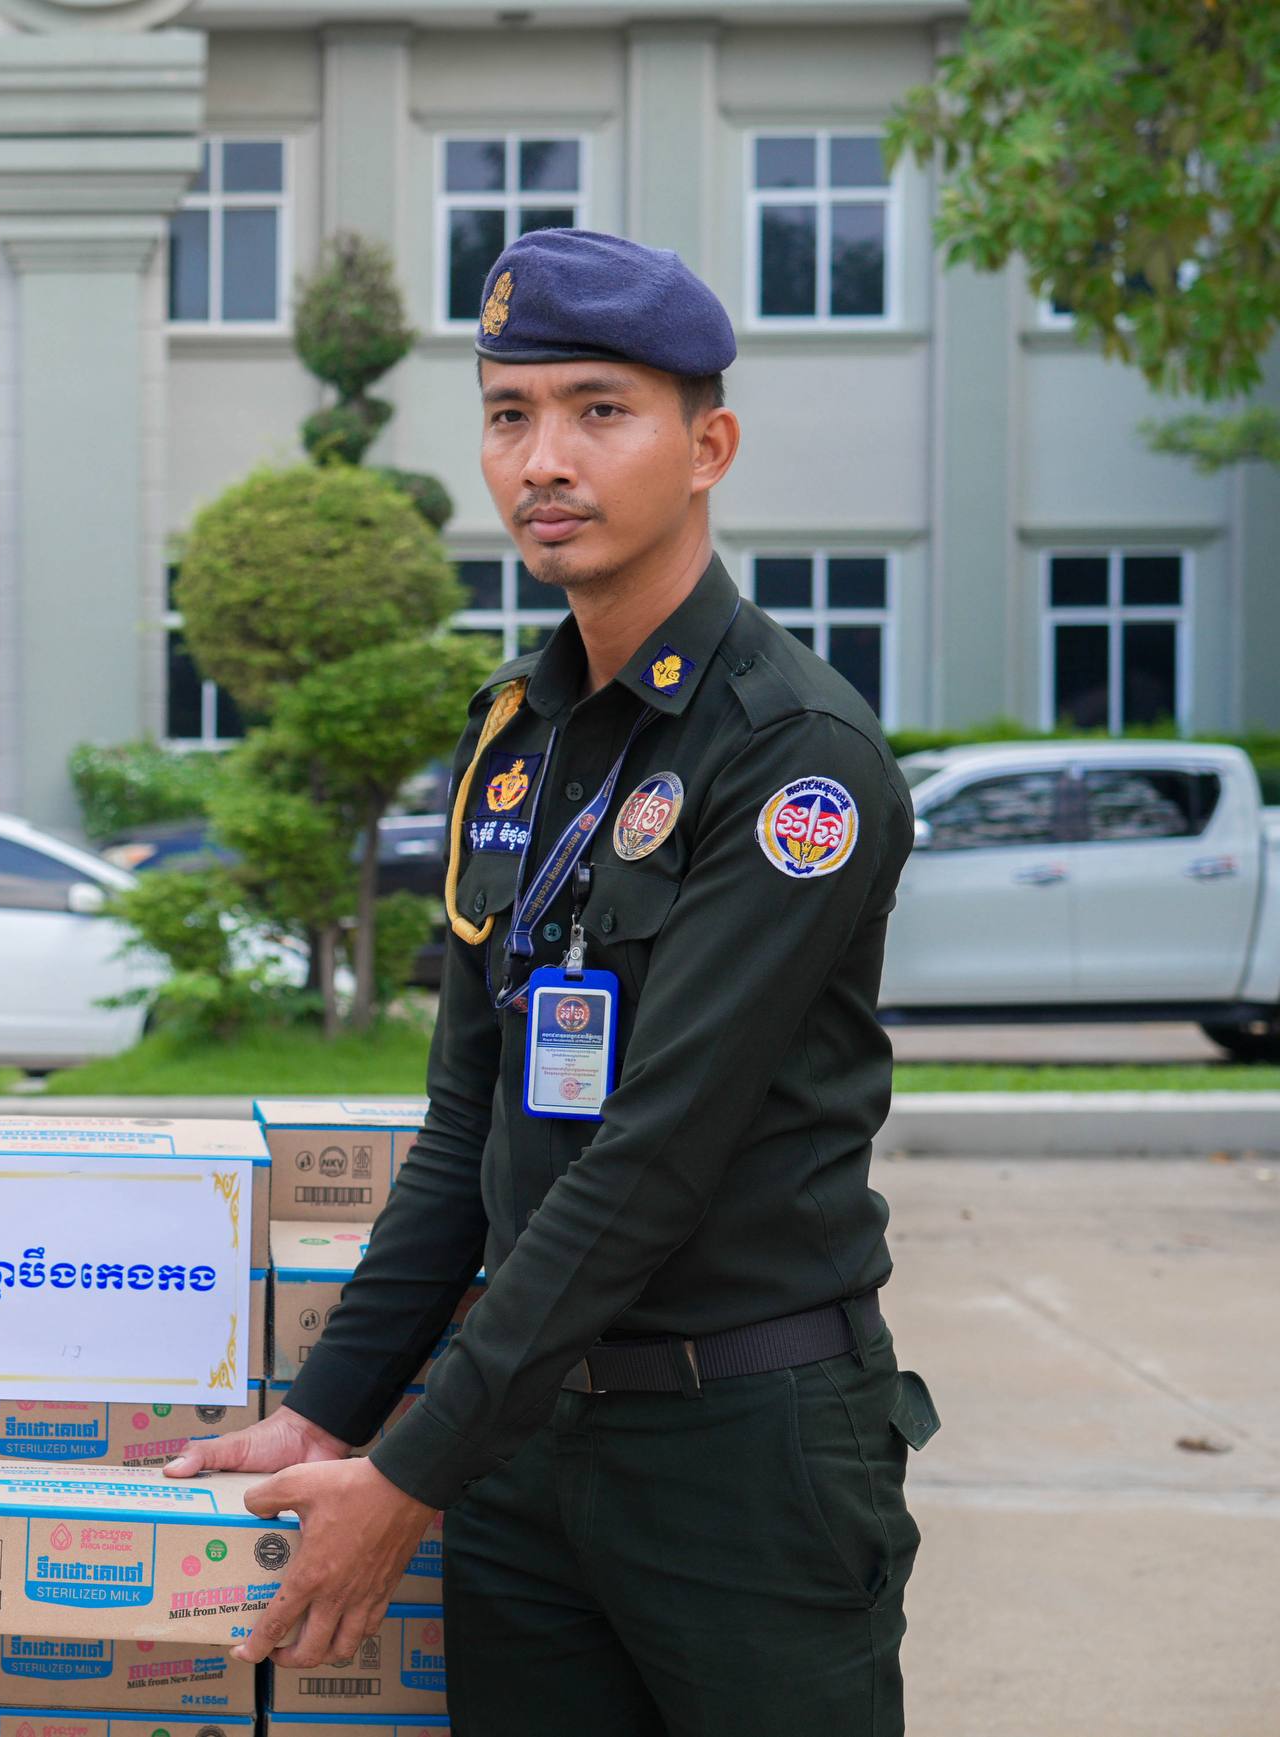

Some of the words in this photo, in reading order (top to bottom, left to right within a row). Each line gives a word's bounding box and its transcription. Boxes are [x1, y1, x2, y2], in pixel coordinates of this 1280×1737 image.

[321, 1159, 344, 1169] NKV
[6, 1443, 67, 1454] STERILIZED
[70, 1444, 97, 1455] MILK
[37, 1586, 107, 1600] STERILIZED
[110, 1590, 141, 1602] MILK
[172, 1586, 247, 1610] HIGHER
[169, 1607, 191, 1619] Milk
[193, 1606, 217, 1617] from
[219, 1604, 240, 1614] New
[241, 1601, 269, 1611] Zeala
[231, 1626, 245, 1638] 24
[10, 1662, 72, 1674] STERILIZED
[75, 1664, 102, 1675] MILK
[128, 1660, 193, 1680] HIGHER
[127, 1680, 146, 1689] Milk
[148, 1678, 169, 1687] from
[170, 1676, 188, 1684] New
[190, 1671, 223, 1682] Zealand
[181, 1695, 193, 1704] 24
